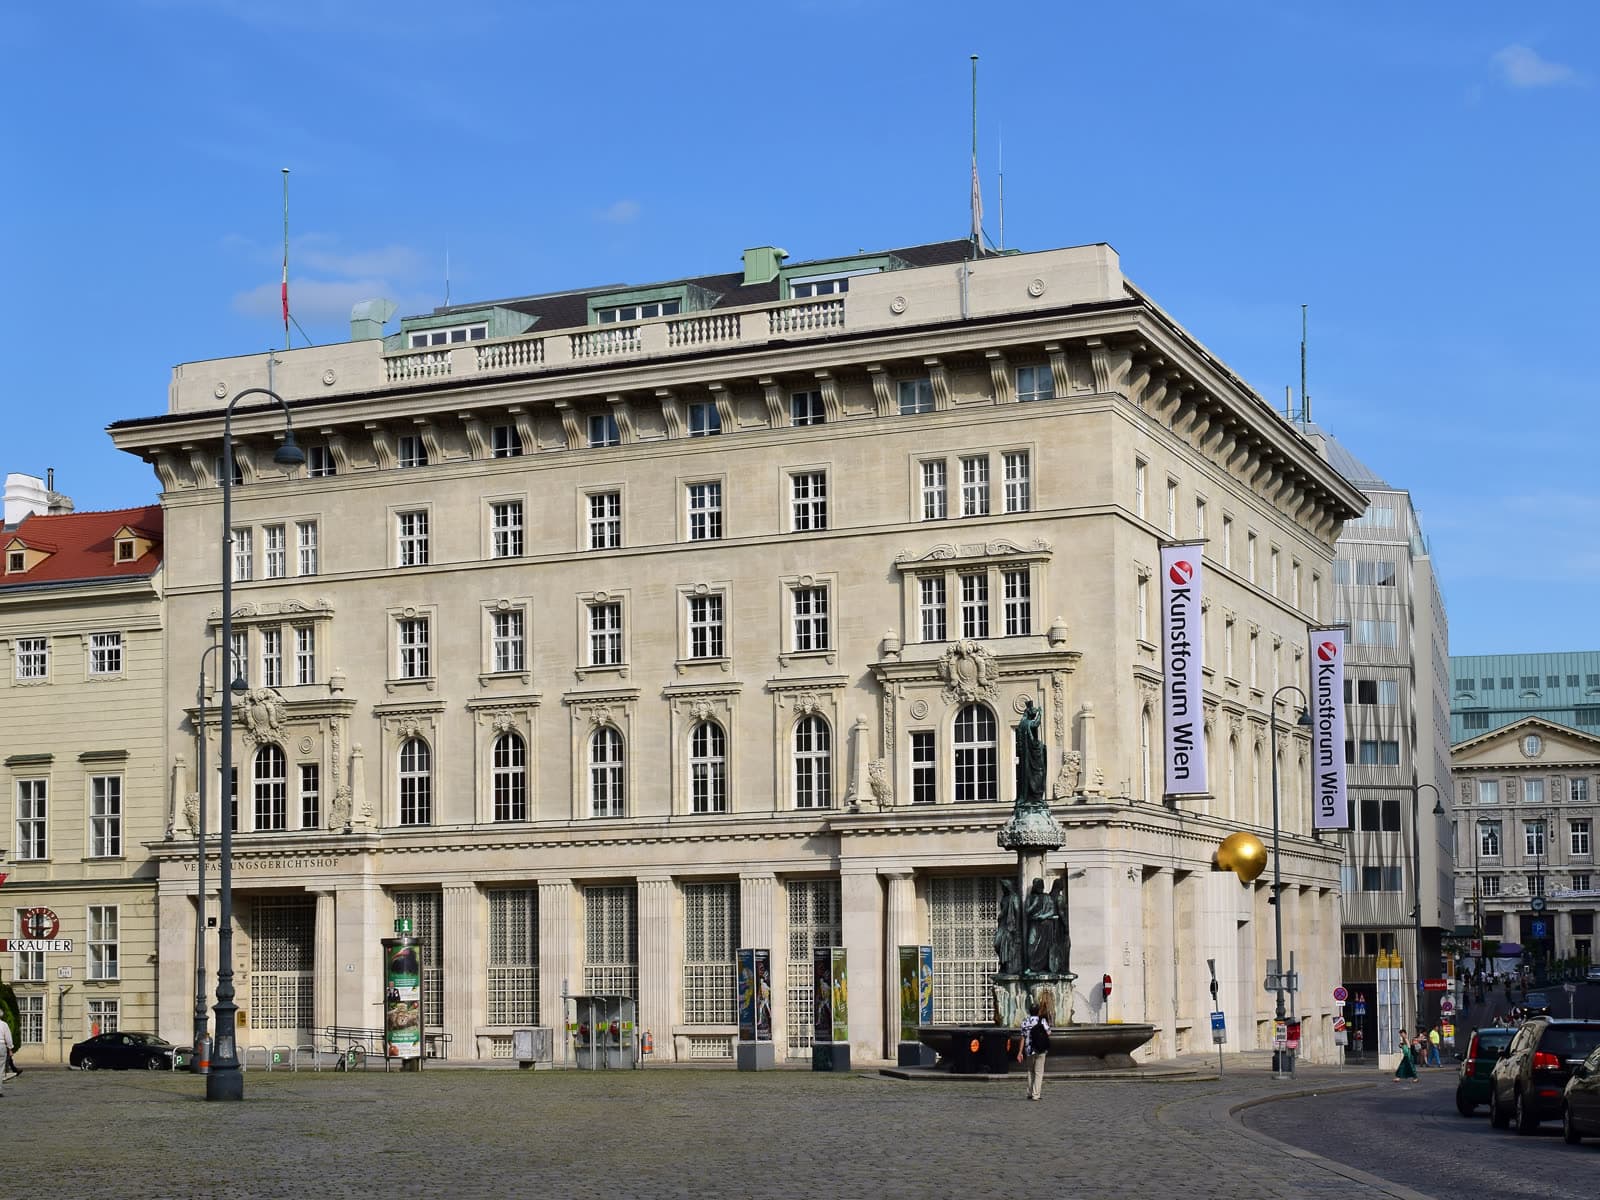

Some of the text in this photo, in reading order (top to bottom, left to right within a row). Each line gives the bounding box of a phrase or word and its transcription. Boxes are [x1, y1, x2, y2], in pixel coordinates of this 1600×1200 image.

[1170, 588, 1194, 780] Kunstforum Wien
[1318, 664, 1339, 817] Kunstforum Wien
[184, 858, 339, 872] VEFASUNGSGERICHTSHOF
